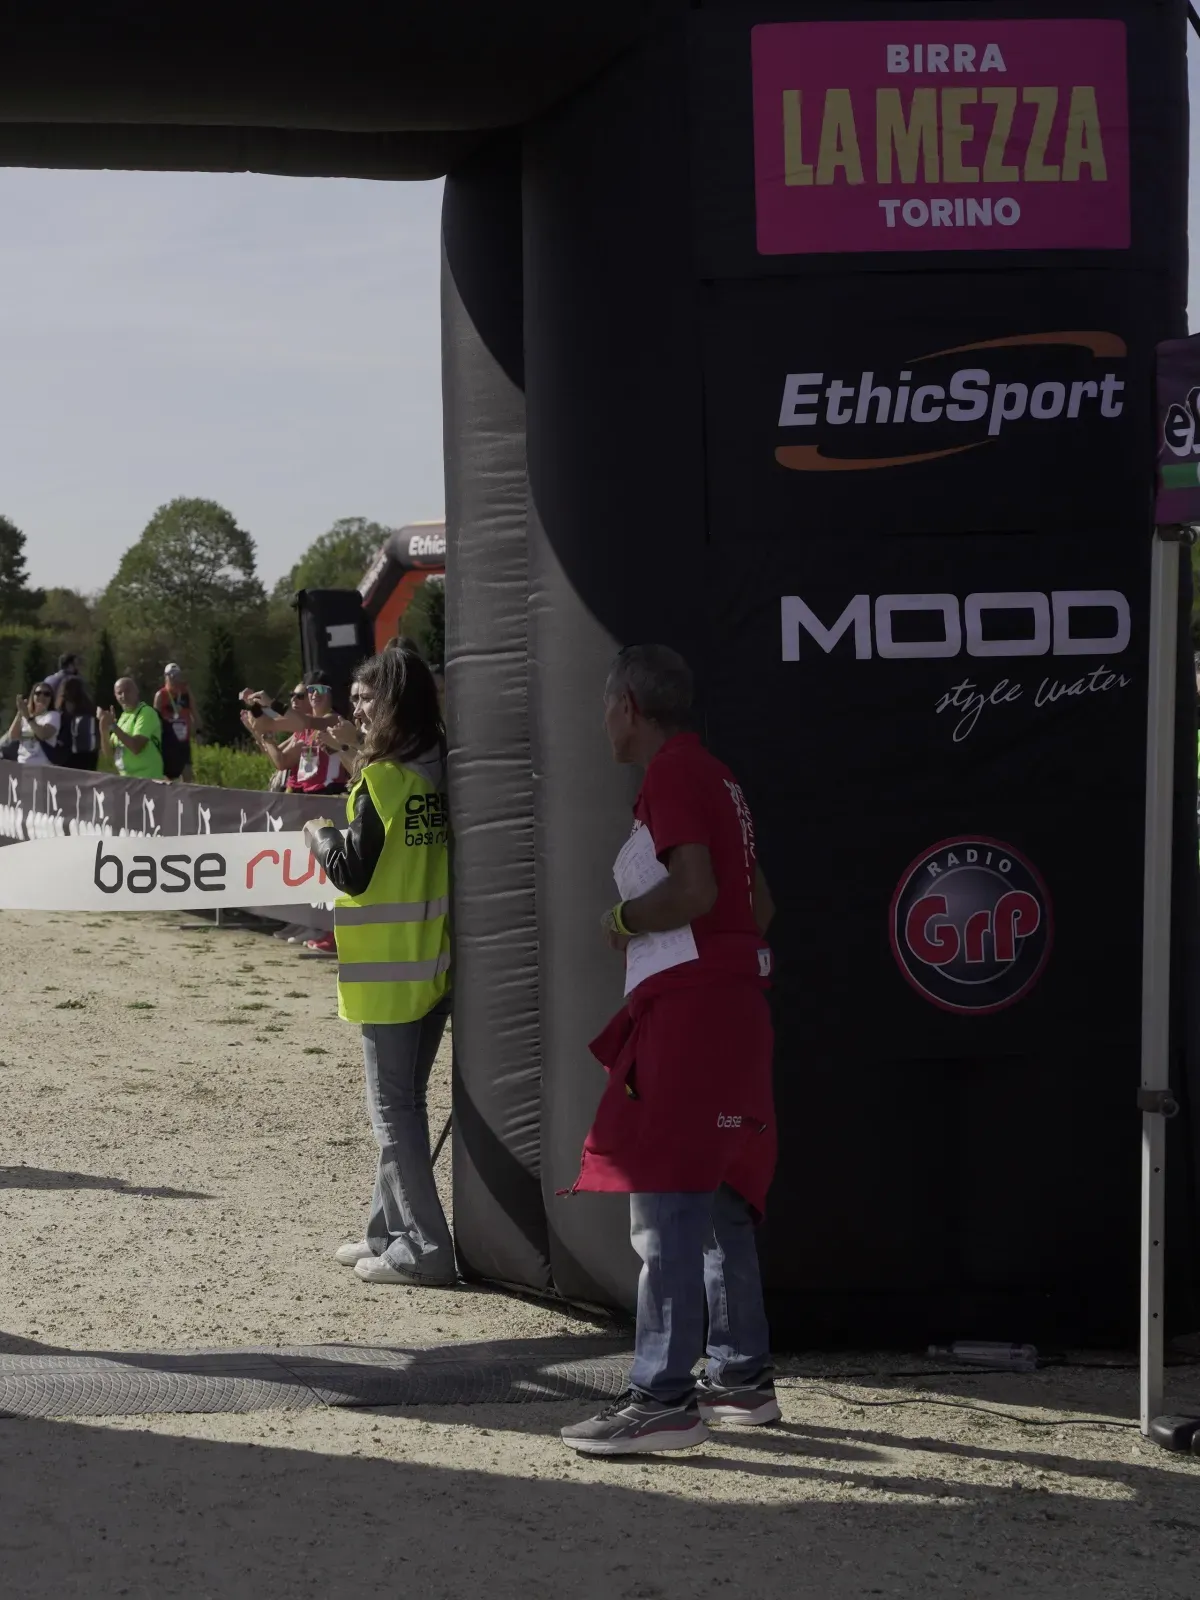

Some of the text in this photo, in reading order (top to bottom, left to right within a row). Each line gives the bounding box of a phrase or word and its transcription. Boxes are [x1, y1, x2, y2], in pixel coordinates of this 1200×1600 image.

[886, 43, 1007, 74] BIRRA
[782, 85, 1108, 187] LA MEZZA
[878, 197, 1021, 228] TORINO
[777, 368, 1125, 436] EthicSport
[781, 590, 1131, 662] MOOD
[934, 678, 1025, 743] style
[405, 831, 434, 846] base
[94, 840, 327, 894] base ru
[926, 849, 1012, 877] RADIO
[717, 1111, 743, 1128] base
